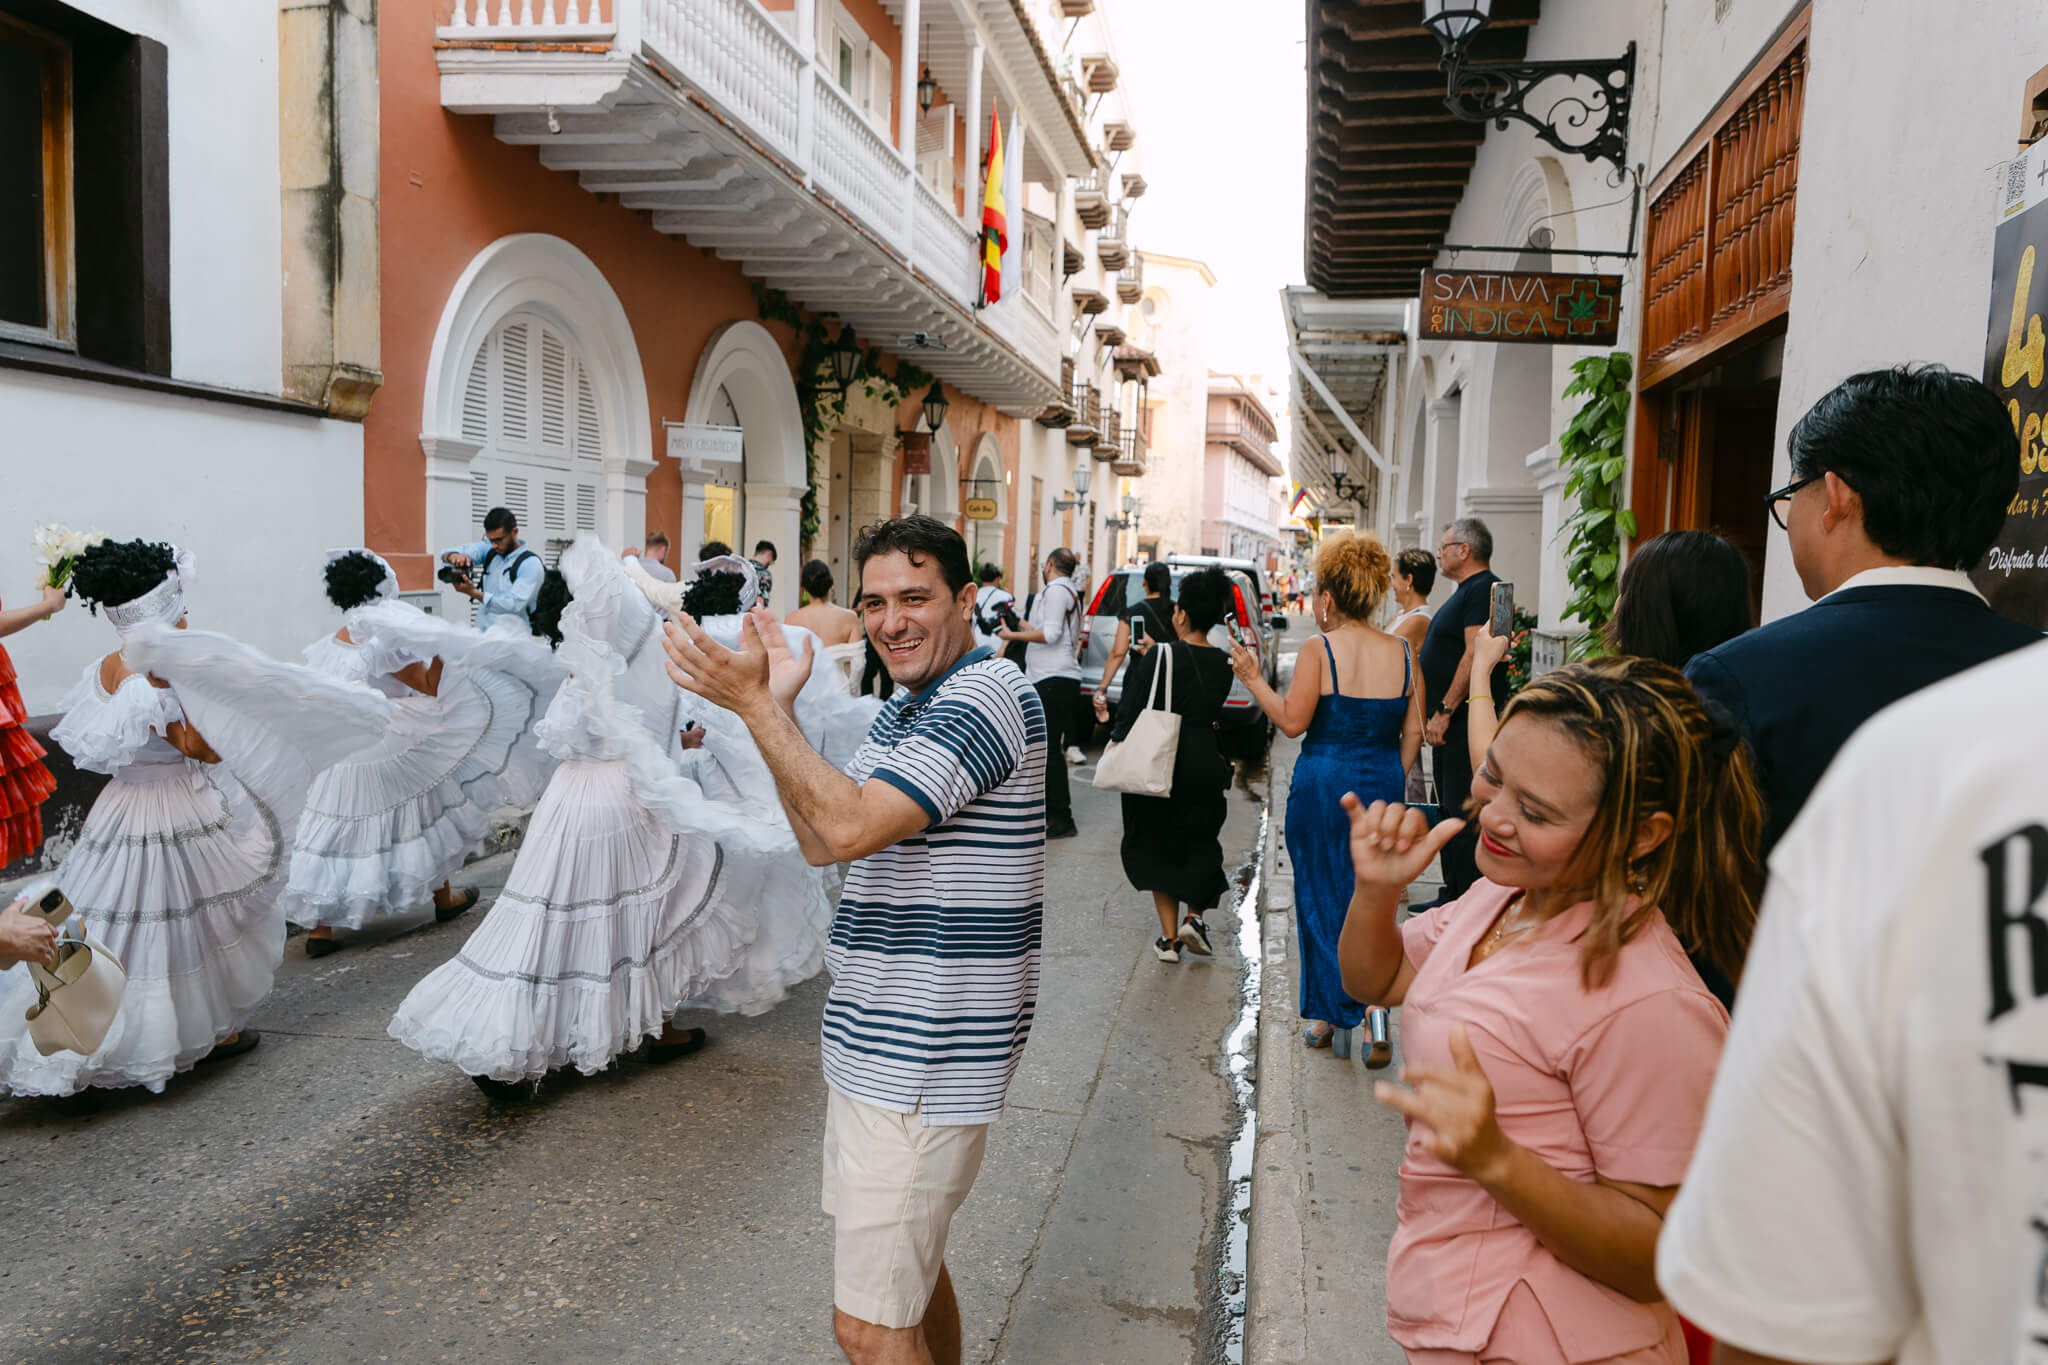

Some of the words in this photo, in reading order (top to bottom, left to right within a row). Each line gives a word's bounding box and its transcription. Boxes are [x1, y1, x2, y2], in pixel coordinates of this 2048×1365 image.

[1433, 273, 1550, 304] SATIVA
[1443, 307, 1548, 337] INDICA
[1988, 546, 2034, 577] Disfruta
